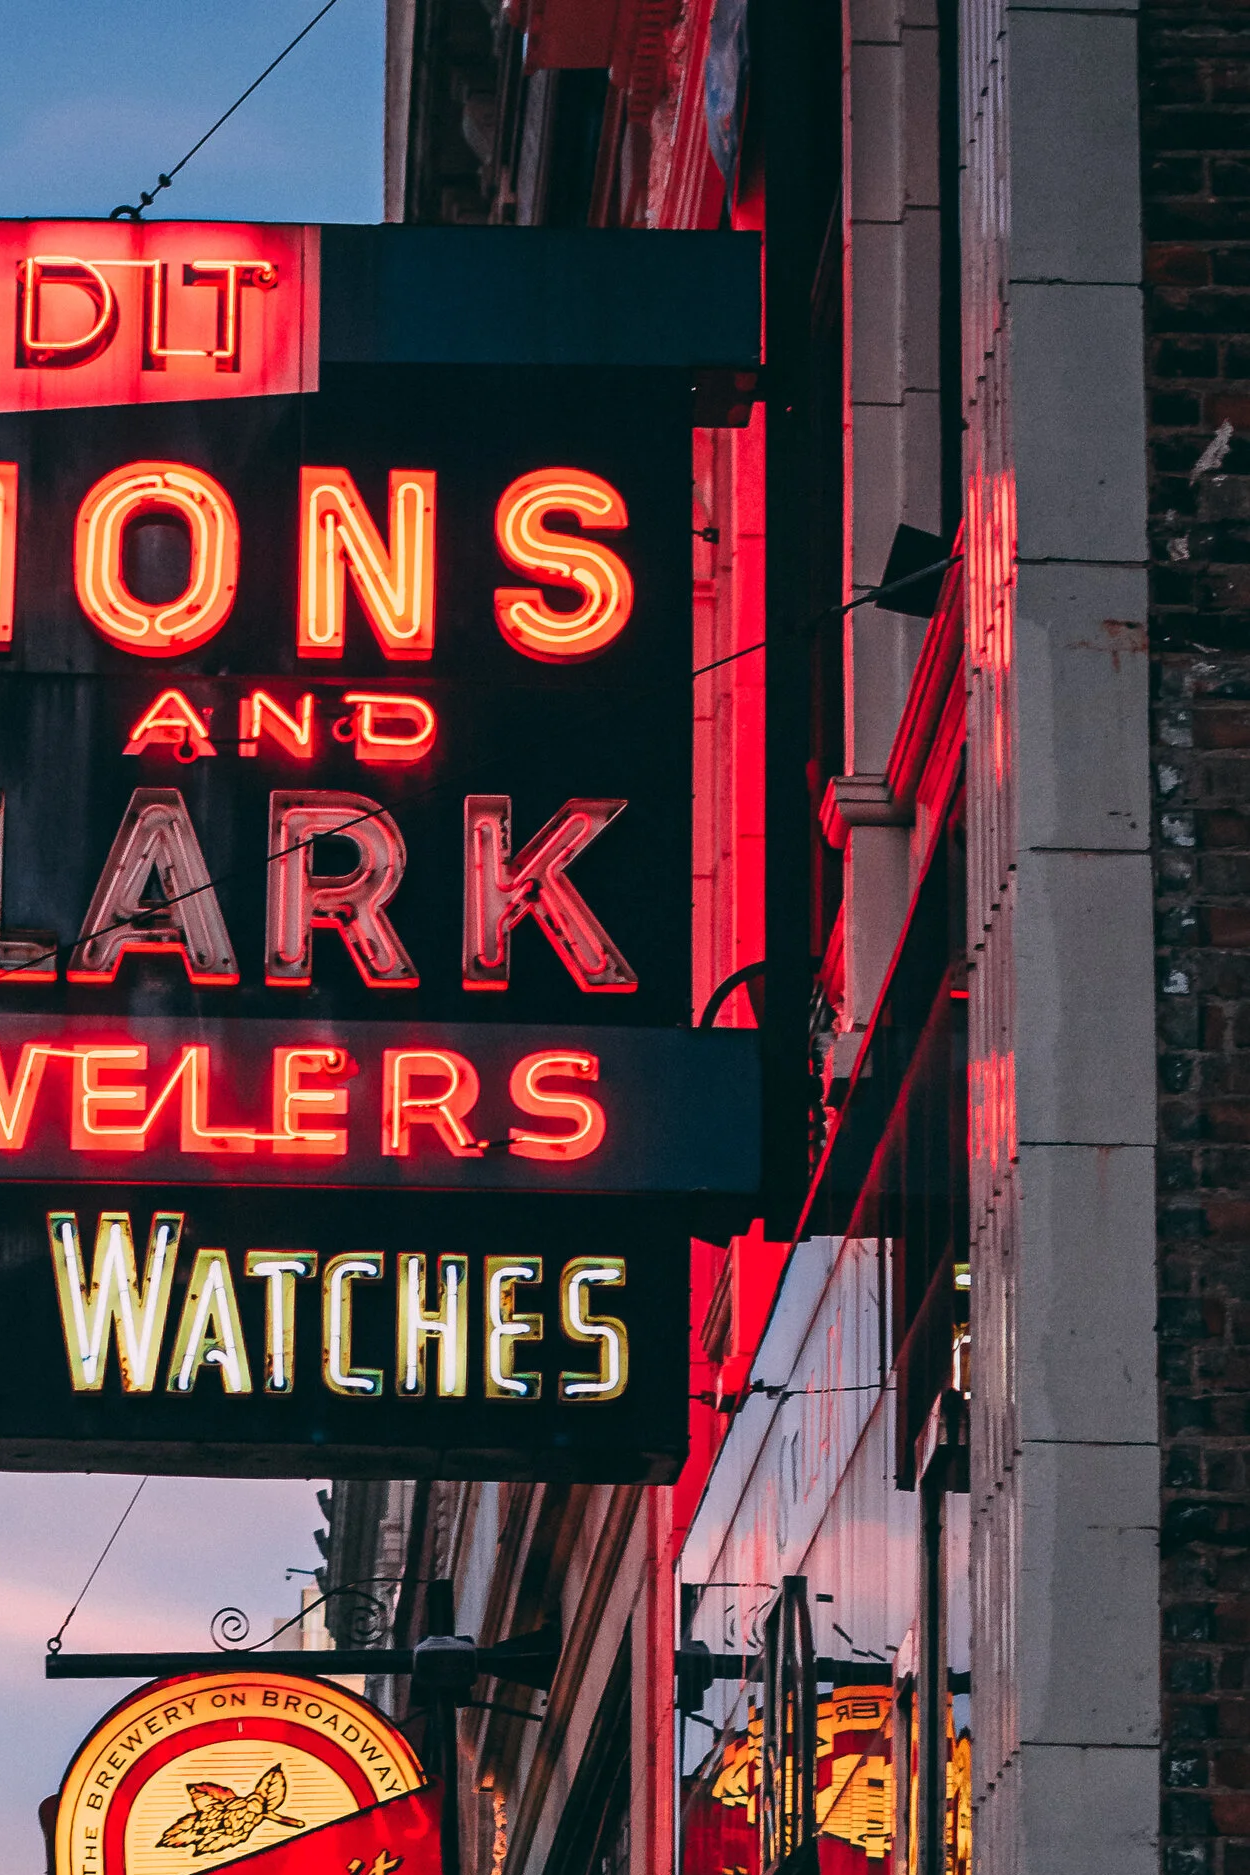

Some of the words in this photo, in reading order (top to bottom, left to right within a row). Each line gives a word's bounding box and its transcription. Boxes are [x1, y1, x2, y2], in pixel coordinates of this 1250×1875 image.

[122, 688, 439, 764] AND
[47, 1210, 630, 1402] WATCHES
[87, 1696, 198, 1812] BREWERY
[210, 1691, 247, 1709] ON
[261, 1689, 404, 1796] BROADWAY
